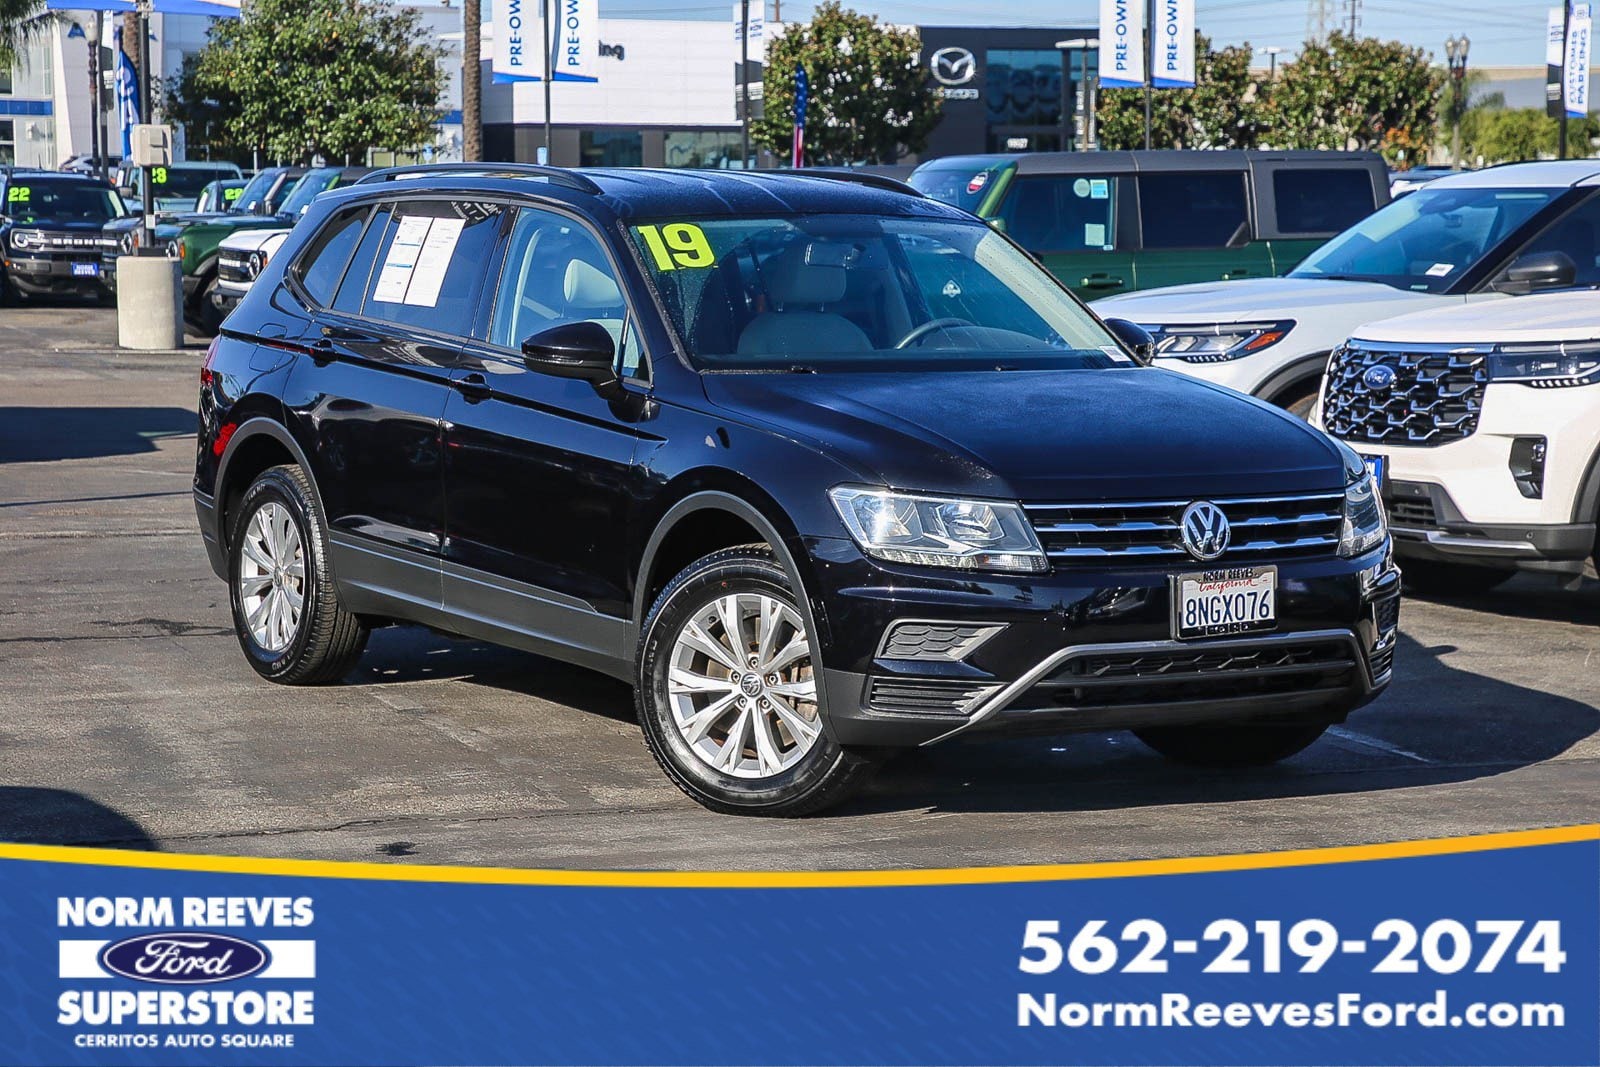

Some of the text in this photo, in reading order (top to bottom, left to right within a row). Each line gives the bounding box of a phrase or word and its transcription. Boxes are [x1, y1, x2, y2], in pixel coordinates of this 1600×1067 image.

[1577, 27, 1587, 105] PARKING
[8, 187, 31, 202] 22
[637, 223, 715, 271] 19
[1199, 579, 1259, 594] California
[1203, 568, 1254, 582] NORM REEVES
[1186, 590, 1271, 626] 8NGX076
